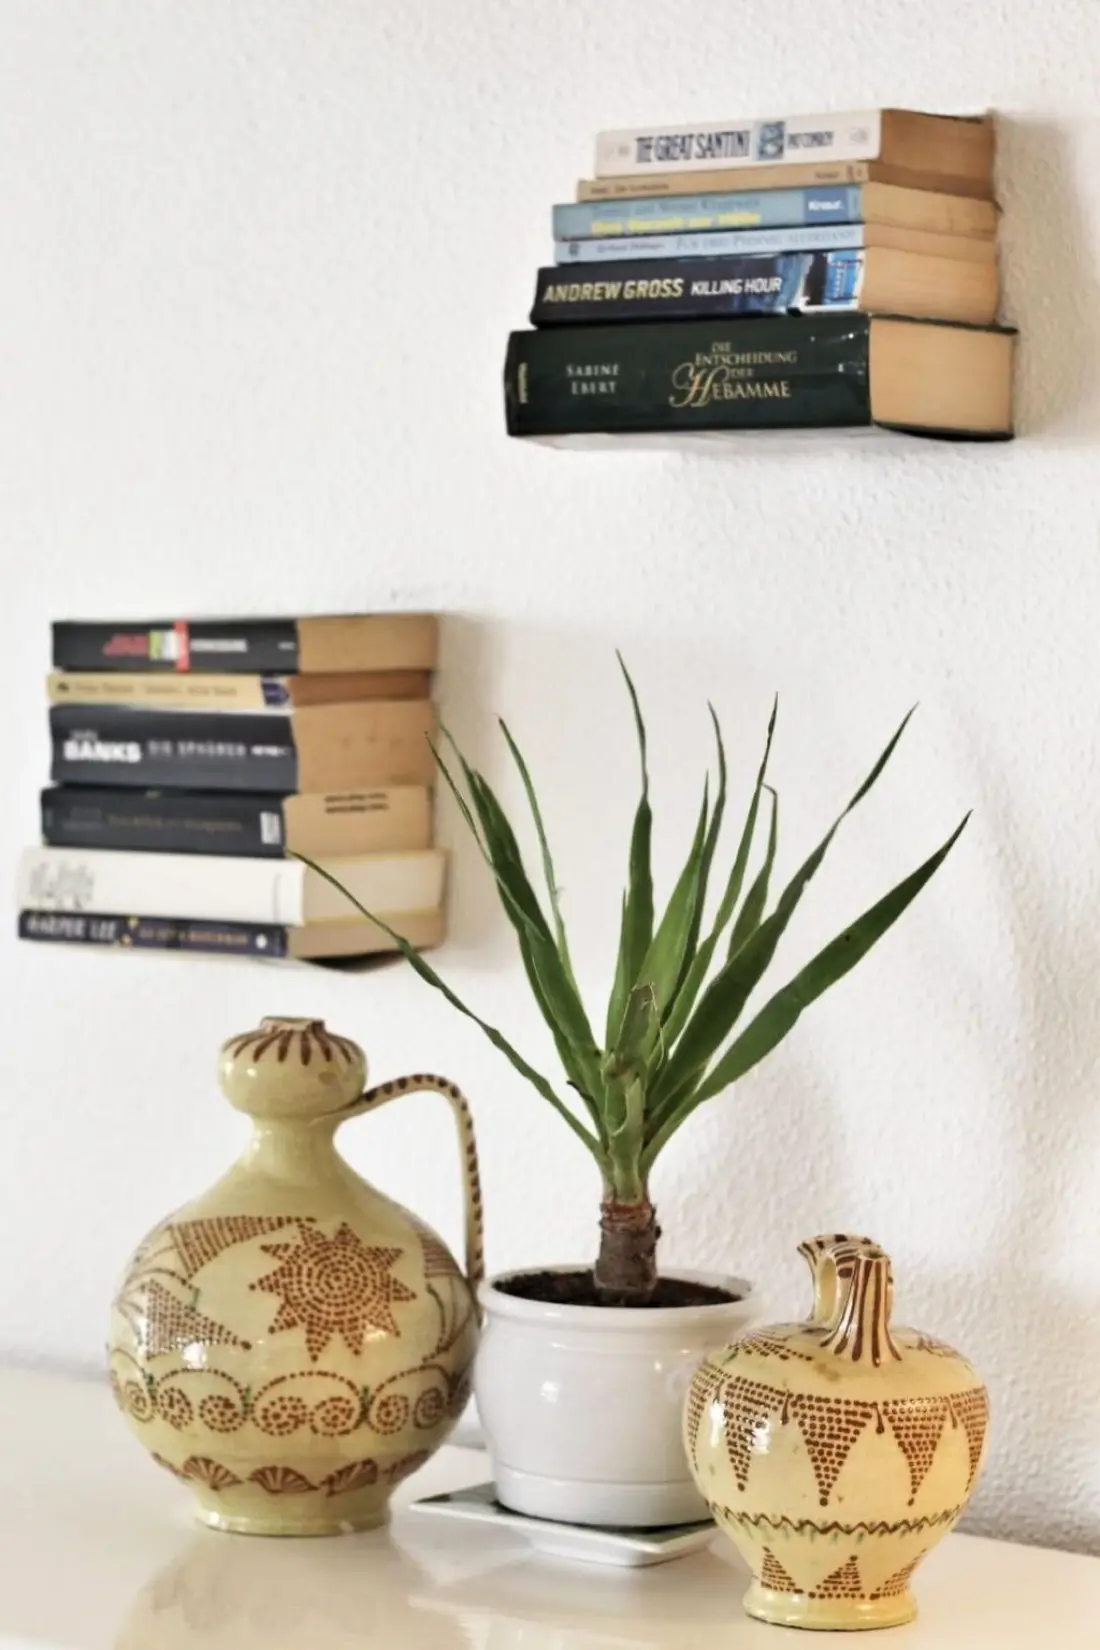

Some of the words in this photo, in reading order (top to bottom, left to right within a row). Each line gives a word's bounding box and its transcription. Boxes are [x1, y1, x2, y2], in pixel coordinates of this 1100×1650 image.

[655, 133, 693, 161] GREAT
[695, 130, 751, 159] SANTINI
[543, 281, 622, 303] ANDREW
[624, 277, 683, 299] GROSS
[690, 278, 743, 297] KILLING
[746, 275, 782, 294] HOUR
[712, 341, 731, 353] DIE
[695, 350, 798, 367] ENTSCHEIDUNG
[566, 363, 619, 377] SABINE
[730, 367, 754, 379] DER
[571, 381, 616, 395] EBERT
[668, 361, 792, 408] HEBAMME
[63, 739, 142, 764] BANKS
